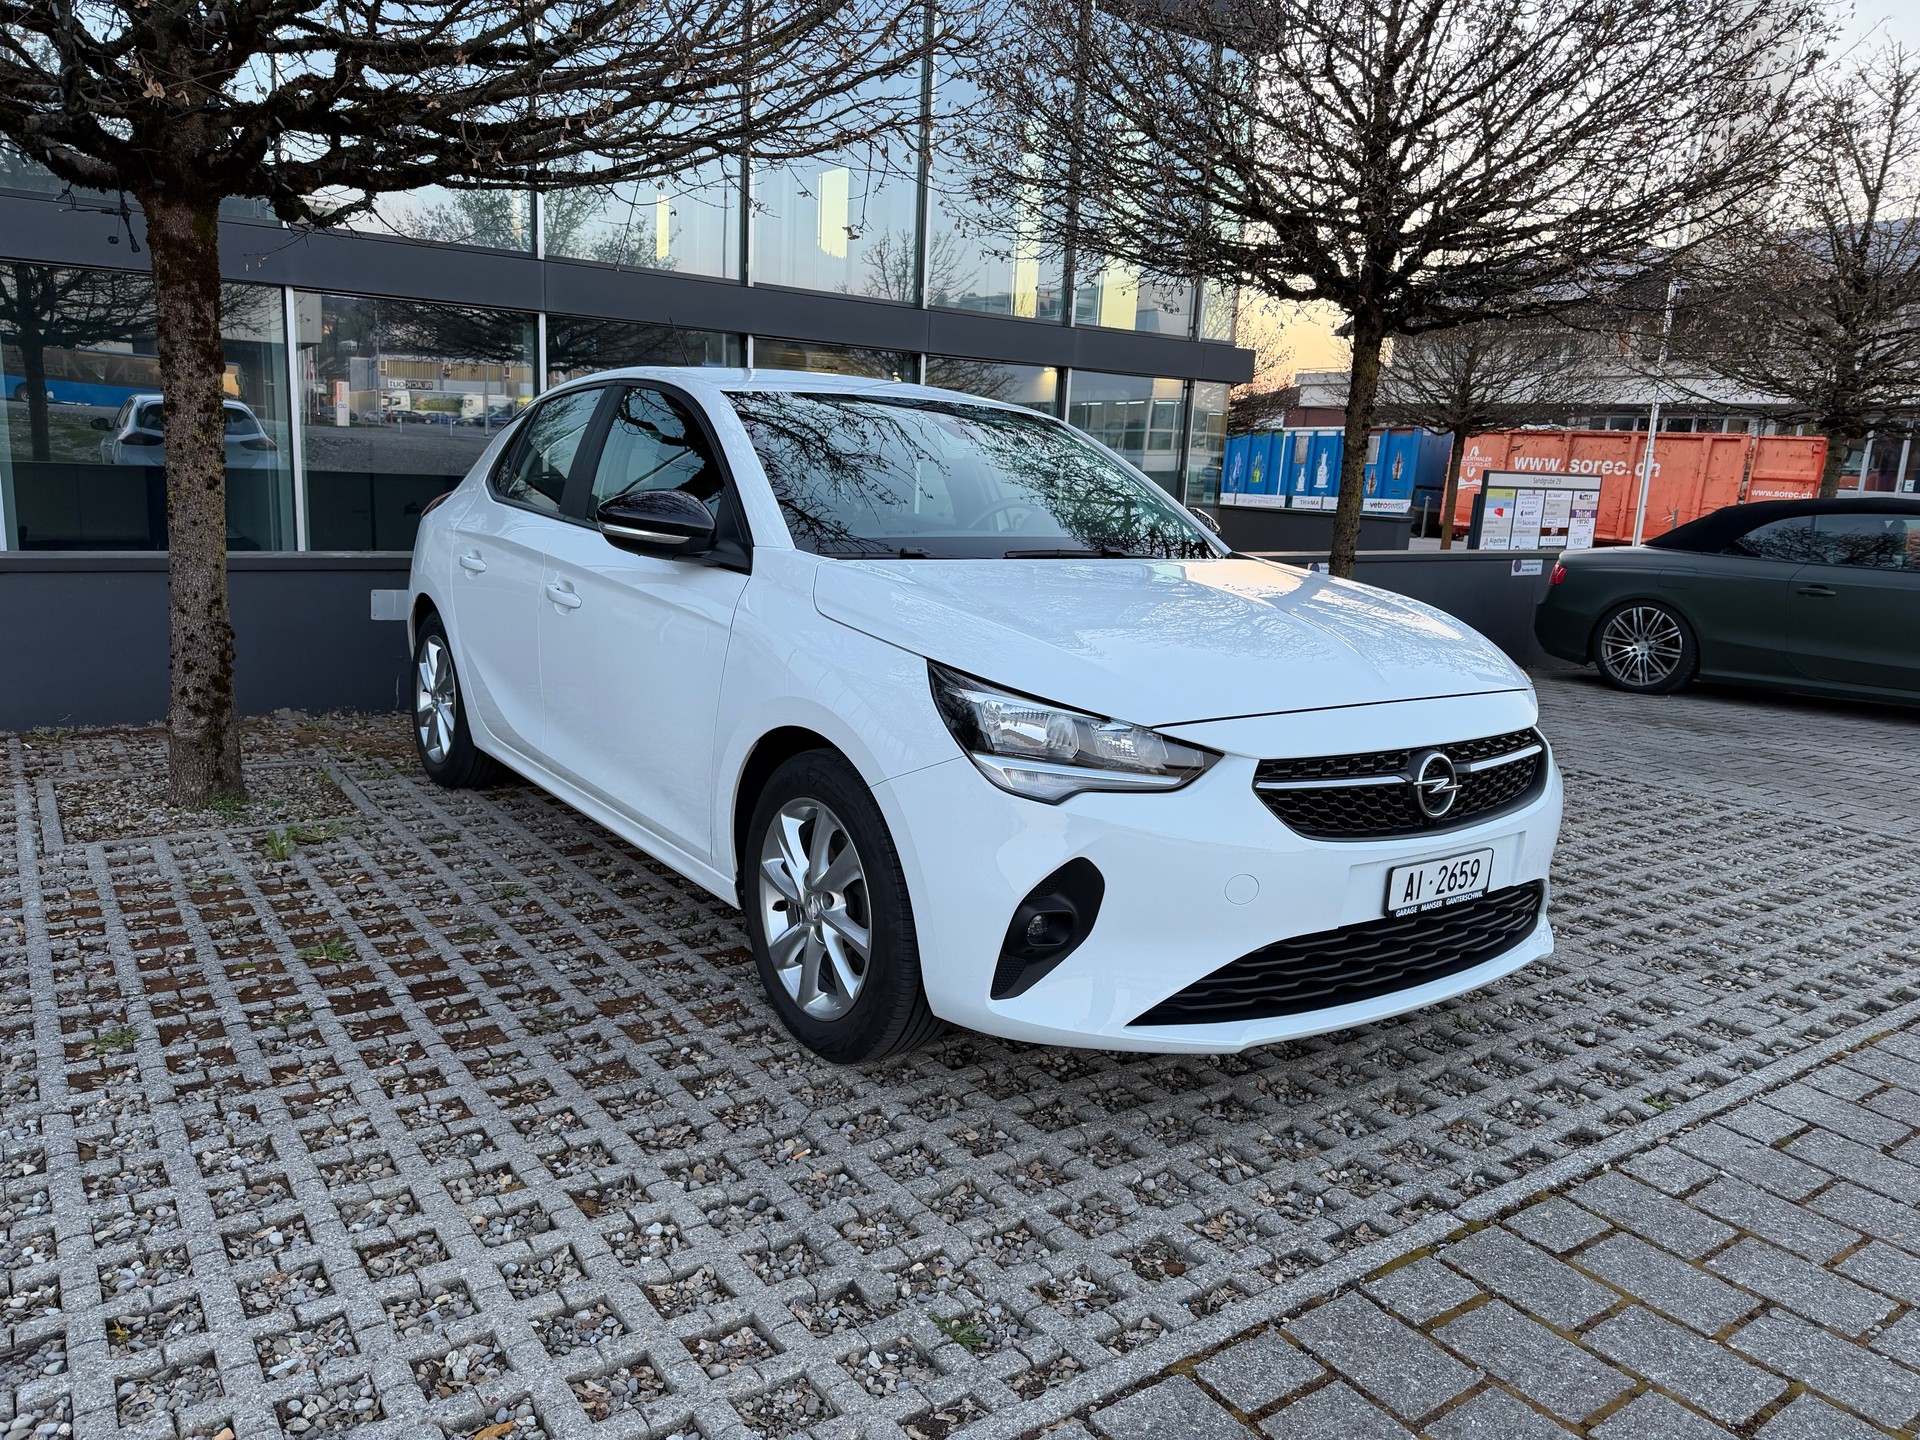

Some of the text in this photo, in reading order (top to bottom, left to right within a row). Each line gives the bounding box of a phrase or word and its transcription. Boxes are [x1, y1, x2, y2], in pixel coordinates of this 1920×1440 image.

[1751, 489, 1813, 499] www.sorec.ch
[1369, 501, 1404, 509] vetroswiss
[1436, 859, 1480, 895] 2659
[1396, 891, 1483, 917] GARAGE MANSER GANTERSCHWIL
